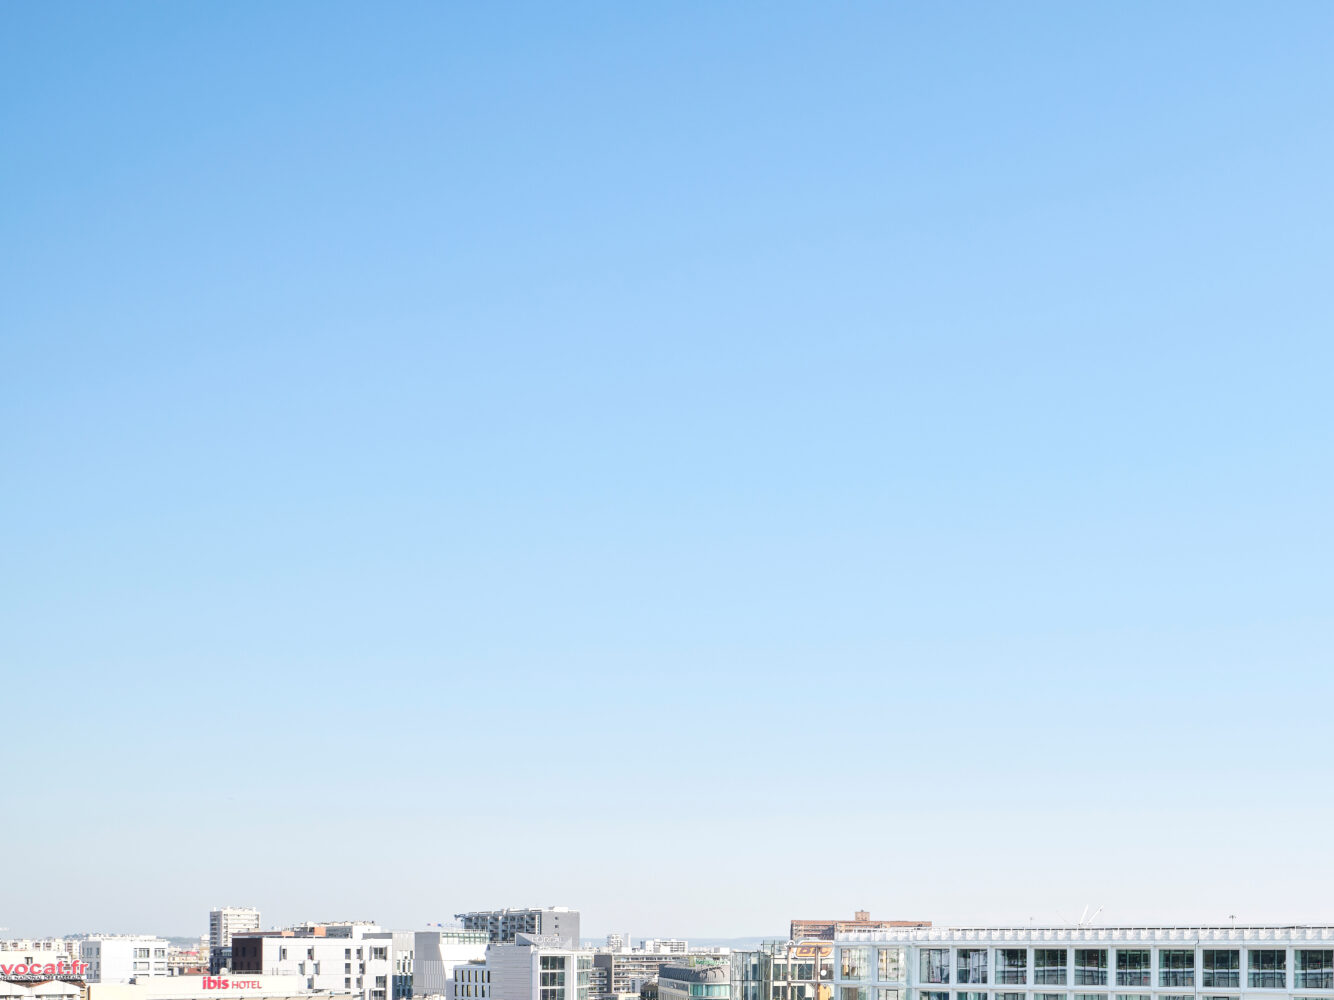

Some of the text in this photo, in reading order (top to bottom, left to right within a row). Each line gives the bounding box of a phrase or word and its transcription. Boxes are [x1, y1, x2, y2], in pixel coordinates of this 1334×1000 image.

[0, 959, 89, 975] vocat.fr
[202, 976, 262, 990] ibis HOTEL
